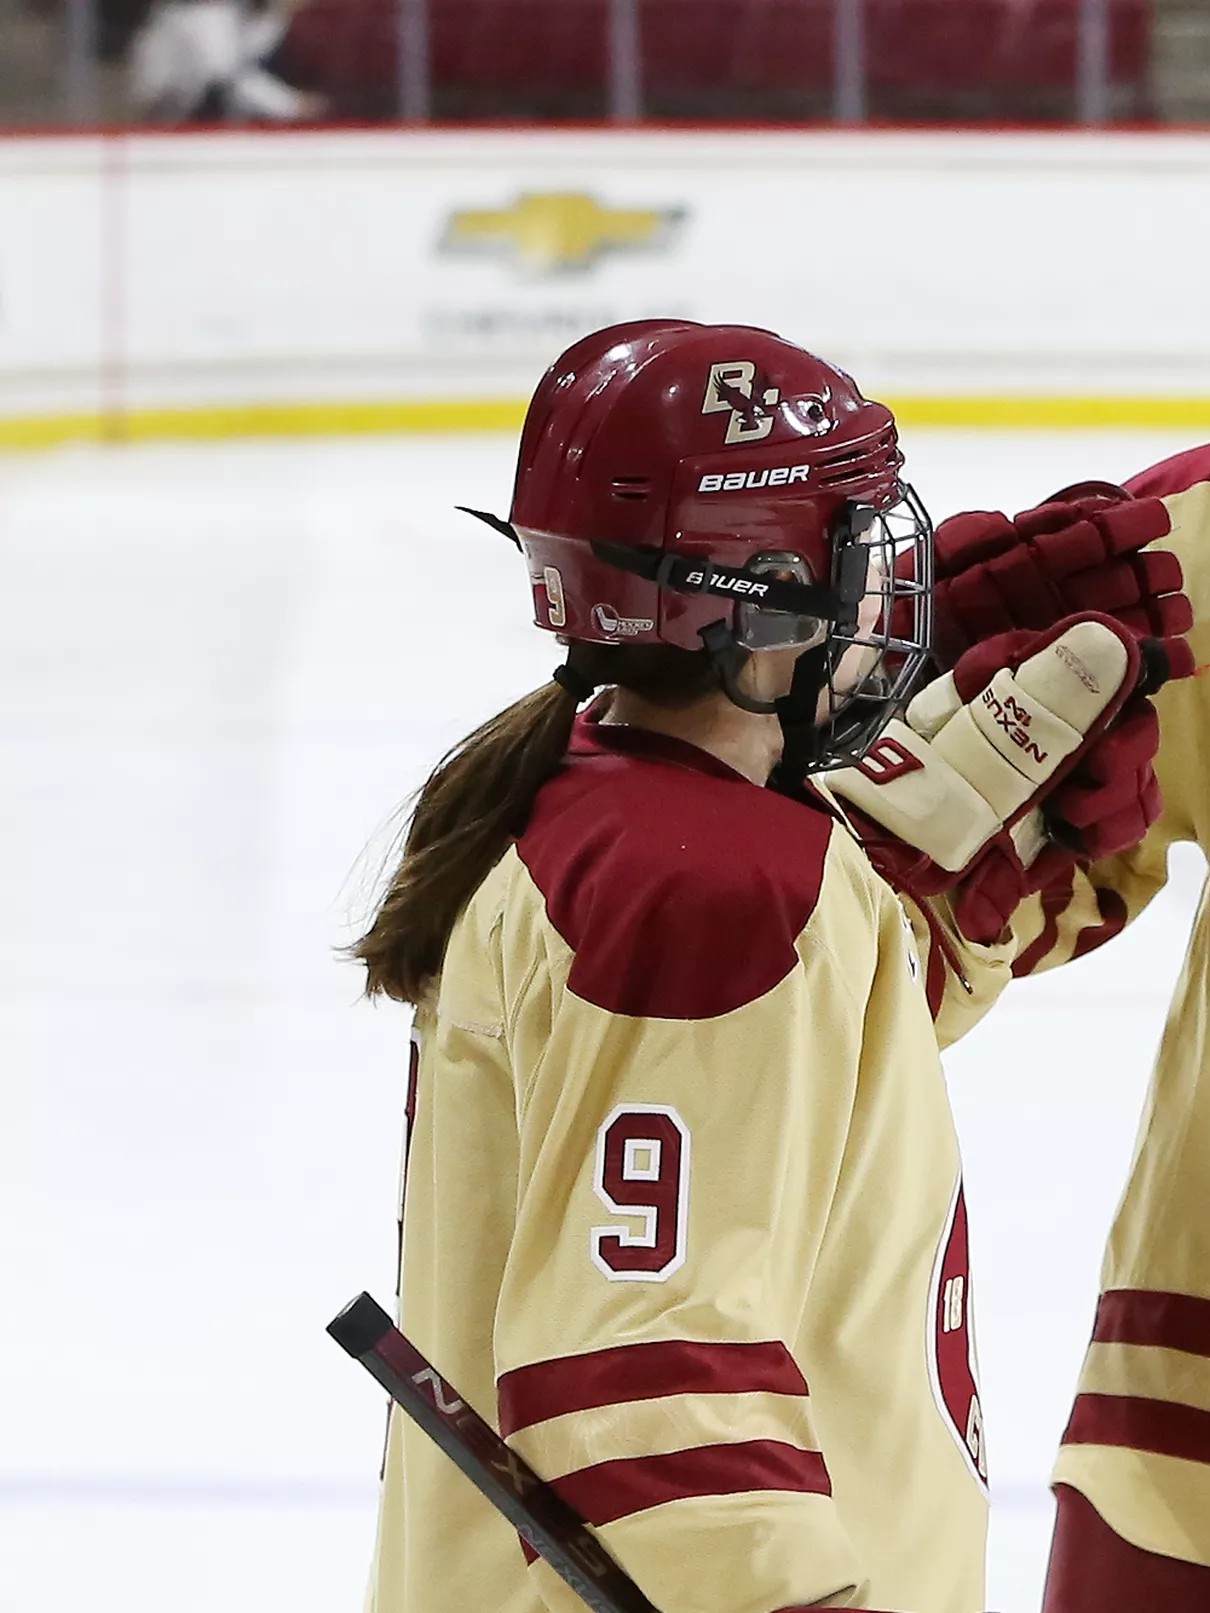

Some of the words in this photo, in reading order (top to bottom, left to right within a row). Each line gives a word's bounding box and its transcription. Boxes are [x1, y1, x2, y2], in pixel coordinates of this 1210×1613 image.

[698, 463, 811, 492] BAUER
[543, 565, 566, 627] 9
[981, 688, 1048, 765] NEXUS
[589, 1102, 692, 1283] 9
[943, 1275, 965, 1334] 18
